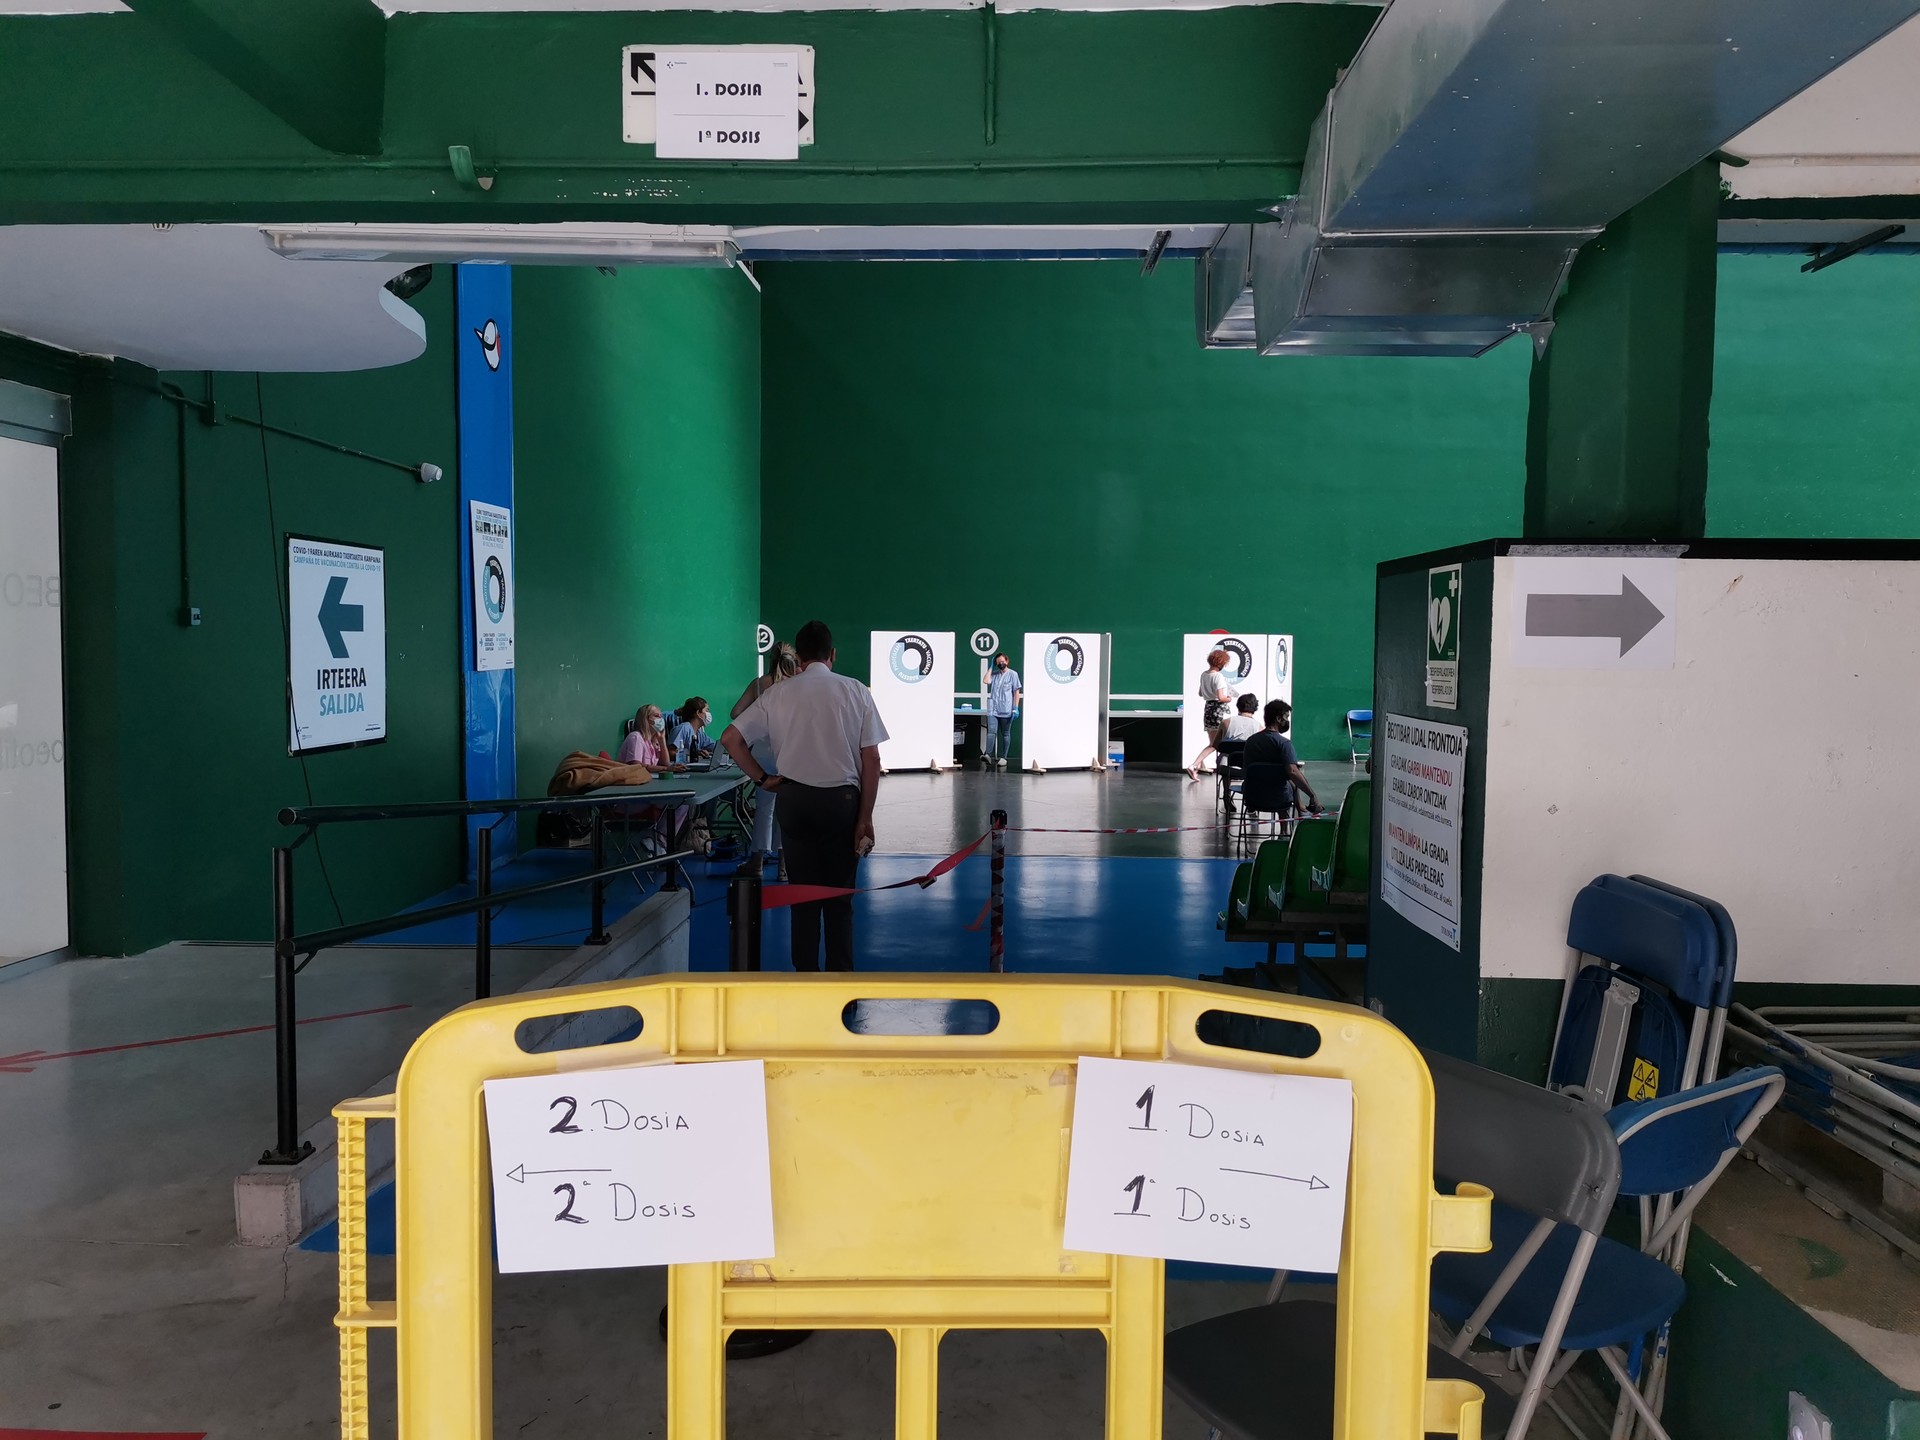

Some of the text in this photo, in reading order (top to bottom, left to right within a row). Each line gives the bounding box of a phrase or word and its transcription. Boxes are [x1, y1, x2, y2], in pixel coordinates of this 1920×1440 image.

[715, 83, 762, 96] DOSIA
[716, 130, 761, 144] DOSIS
[977, 636, 991, 648] 11
[317, 667, 367, 690] IRTEERA
[319, 692, 365, 717] SALIDA
[1387, 721, 1463, 757] BEOTIBAR UDAL FRONTOIA
[1407, 759, 1421, 777] GARBI
[1421, 763, 1453, 787] MANTENDU
[1408, 782, 1423, 802] ZABOR
[1424, 788, 1448, 811] ONTZIAK
[1422, 838, 1429, 857] LA
[1429, 842, 1449, 866] GRADA
[1405, 855, 1414, 873] LAS
[1415, 860, 1445, 888] PAPELERAS
[549, 1095, 594, 1135] 2.
[1128, 1084, 1168, 1132] 1.
